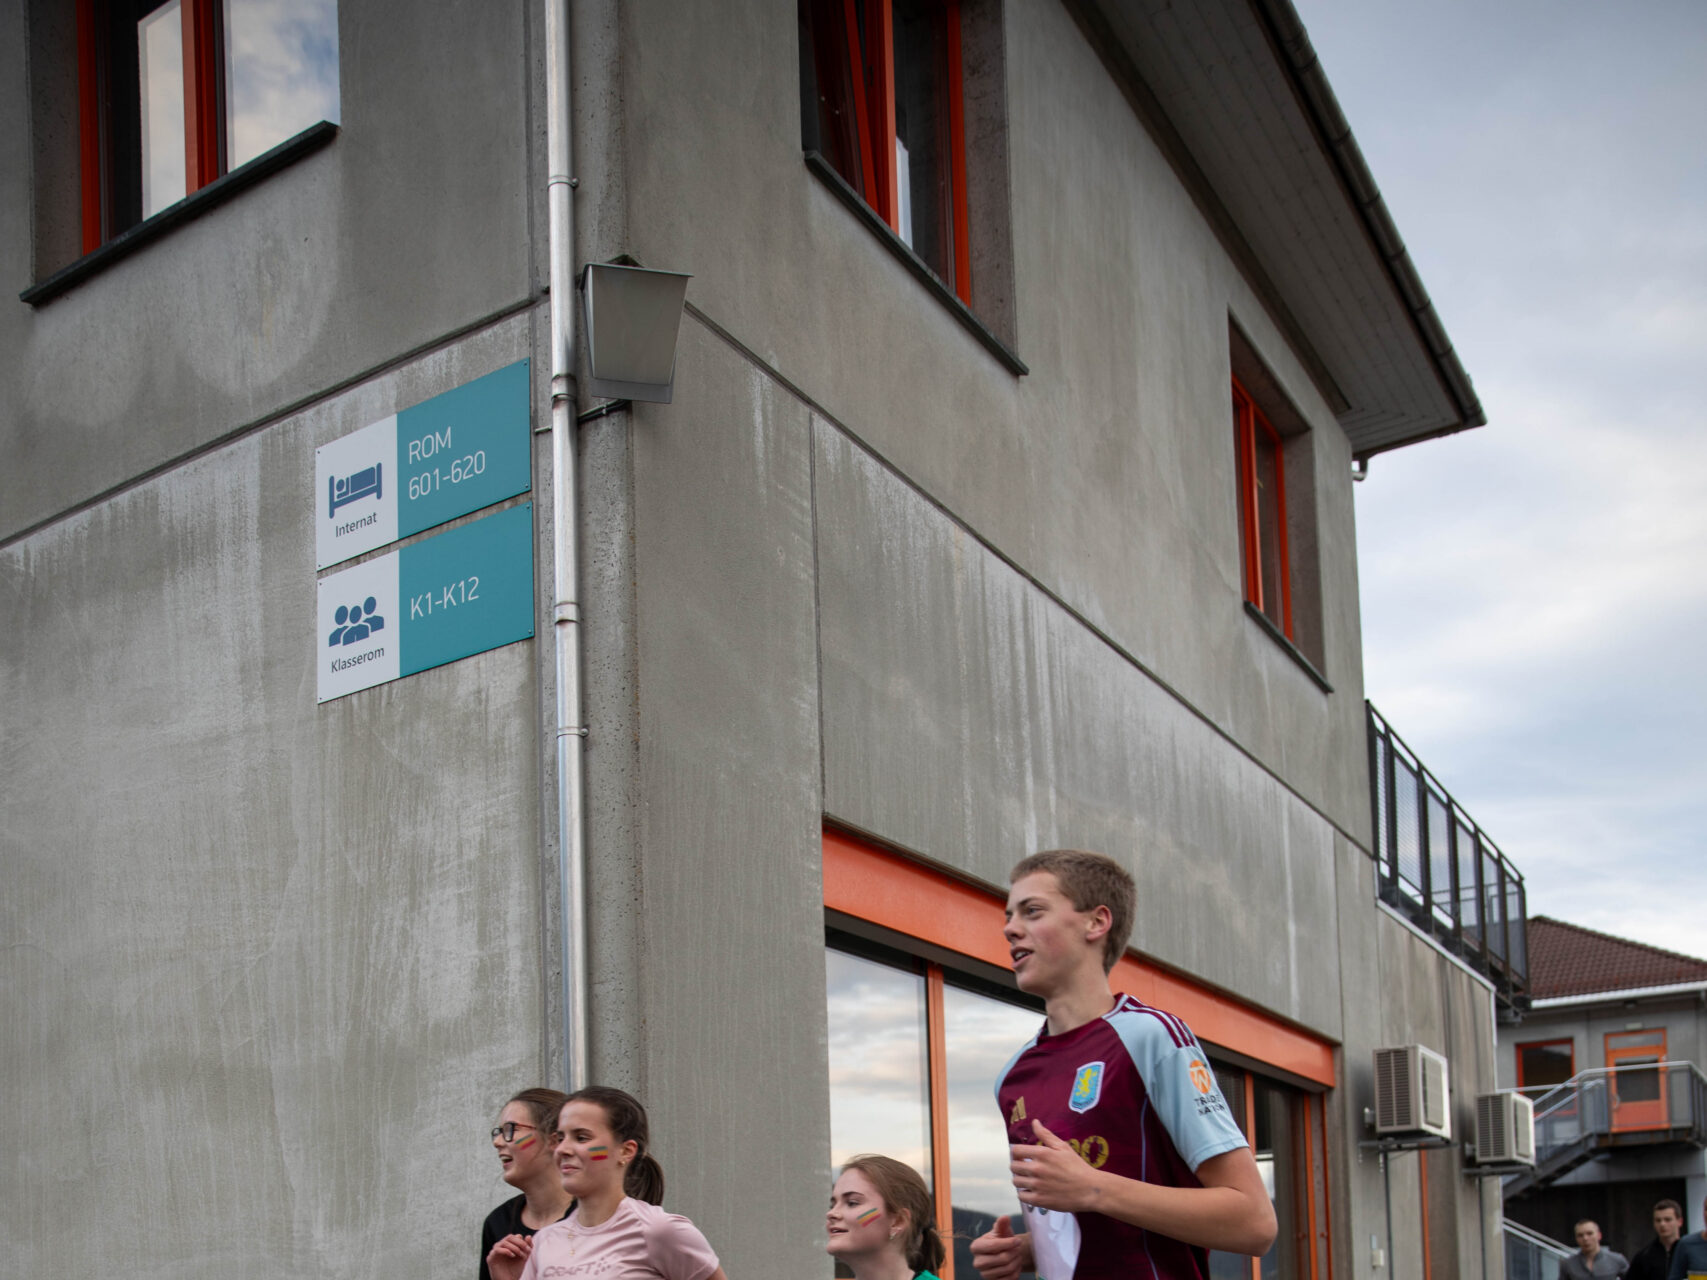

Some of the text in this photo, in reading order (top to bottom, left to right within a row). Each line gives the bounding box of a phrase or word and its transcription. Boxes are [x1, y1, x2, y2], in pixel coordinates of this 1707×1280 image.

[409, 426, 451, 465] ROM
[409, 450, 486, 500] 601-620
[335, 512, 378, 537] Internat
[410, 576, 480, 621] K1-K12
[331, 647, 385, 673] Klasserom
